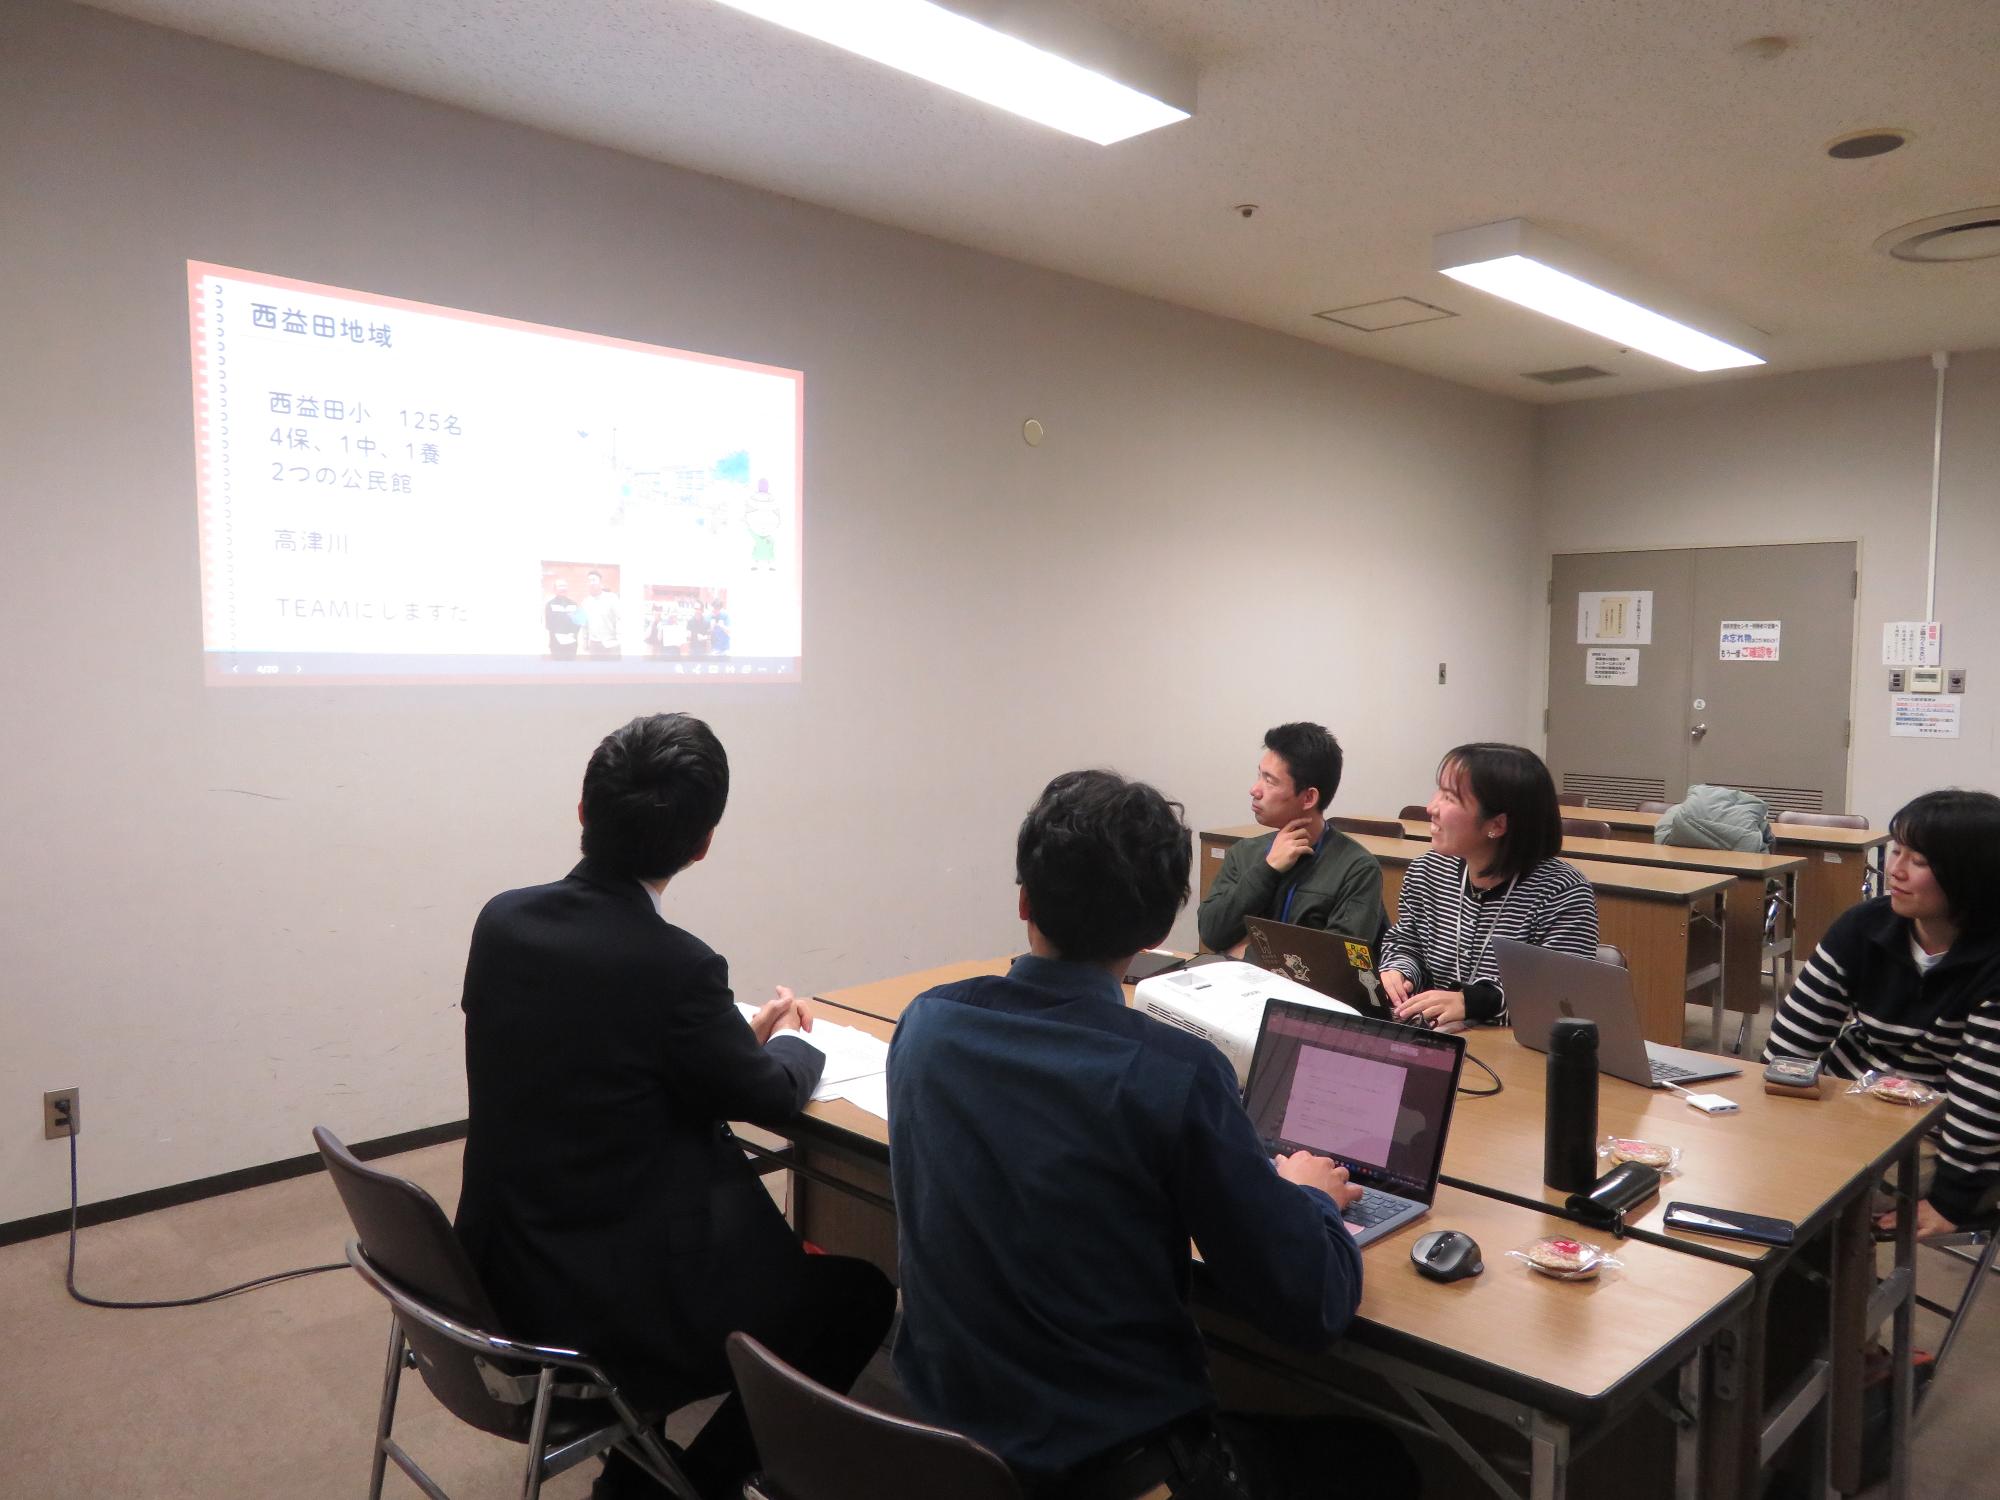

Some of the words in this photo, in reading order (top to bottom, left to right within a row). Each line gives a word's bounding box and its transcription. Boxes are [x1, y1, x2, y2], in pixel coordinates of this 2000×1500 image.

[250, 302, 393, 349] 西益田地域
[268, 390, 371, 424] 西益田小
[399, 408, 463, 436] 125名
[269, 426, 440, 465] 4保、1中、1養
[271, 461, 413, 494] 2つの公民館
[273, 528, 350, 555] 高津川
